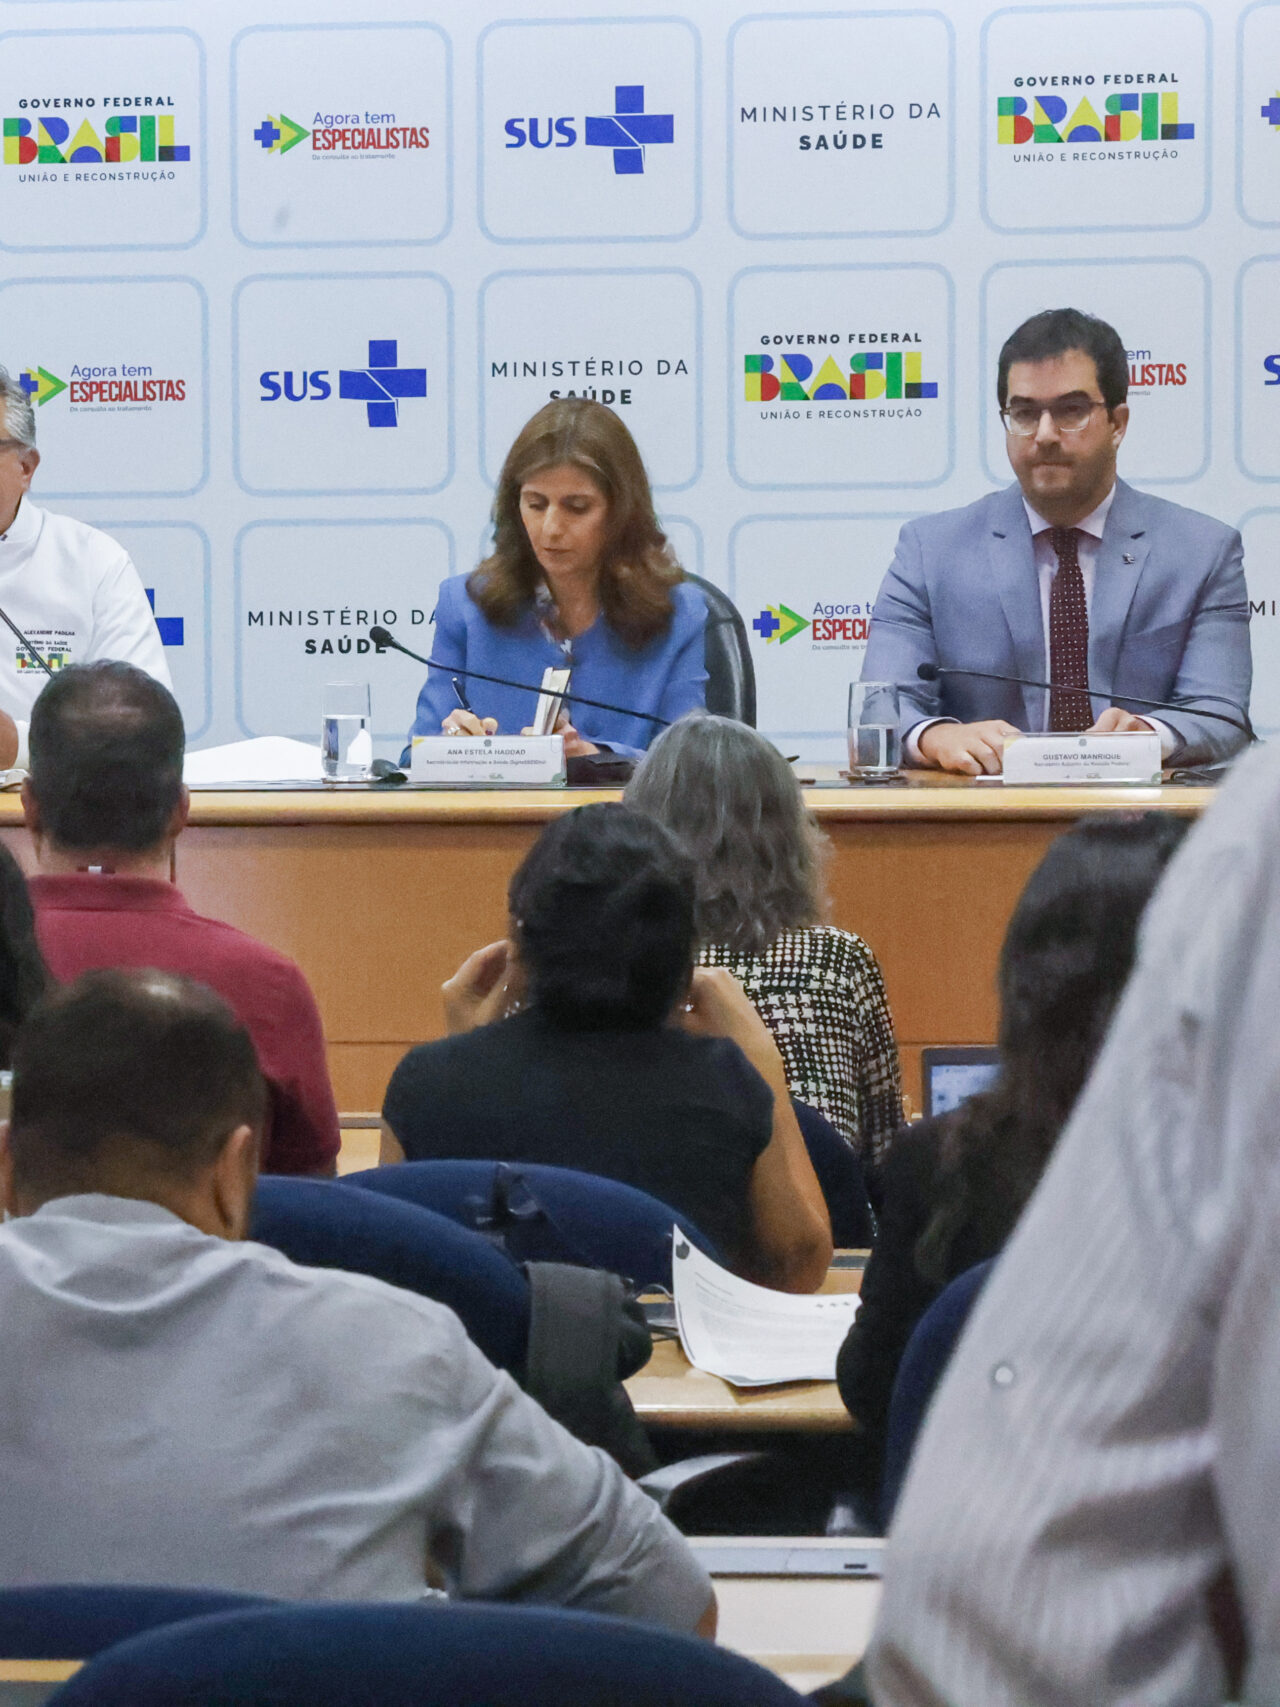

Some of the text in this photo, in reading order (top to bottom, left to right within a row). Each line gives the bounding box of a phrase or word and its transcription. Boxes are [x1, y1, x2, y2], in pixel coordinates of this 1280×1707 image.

[1014, 73, 1179, 88] GOVERNO FEDERAL
[19, 97, 175, 109] GOVERNO FEDERAL
[741, 101, 941, 123] MINISTÉRIO DA
[313, 112, 396, 129] Agora tem
[998, 93, 1194, 144] BRASIL
[3, 116, 190, 164] BRASIL
[313, 128, 429, 150] ESPECIALISTAS
[505, 117, 577, 148] SUS
[800, 130, 884, 151] SAÚDE
[1014, 149, 1179, 163] UNIÃO E RECONSTRUÇÃO
[19, 170, 176, 183] UNIÃO E RECONSTRUÇÃO
[761, 333, 922, 346] GOVERNO FEDERAL
[1125, 350, 1151, 360] em
[70, 364, 153, 381] Agora tem
[492, 357, 689, 378] MINISTÉRIO DA
[745, 352, 938, 401] BRASIL
[71, 380, 185, 402] ESPECIALISTAS
[260, 371, 331, 401] SUS
[761, 408, 922, 420] UNIÃO E RECONSTRUÇÃO
[247, 606, 398, 627] MINISTÉRIO
[813, 602, 861, 619] Agora
[448, 748, 462, 756] ANA
